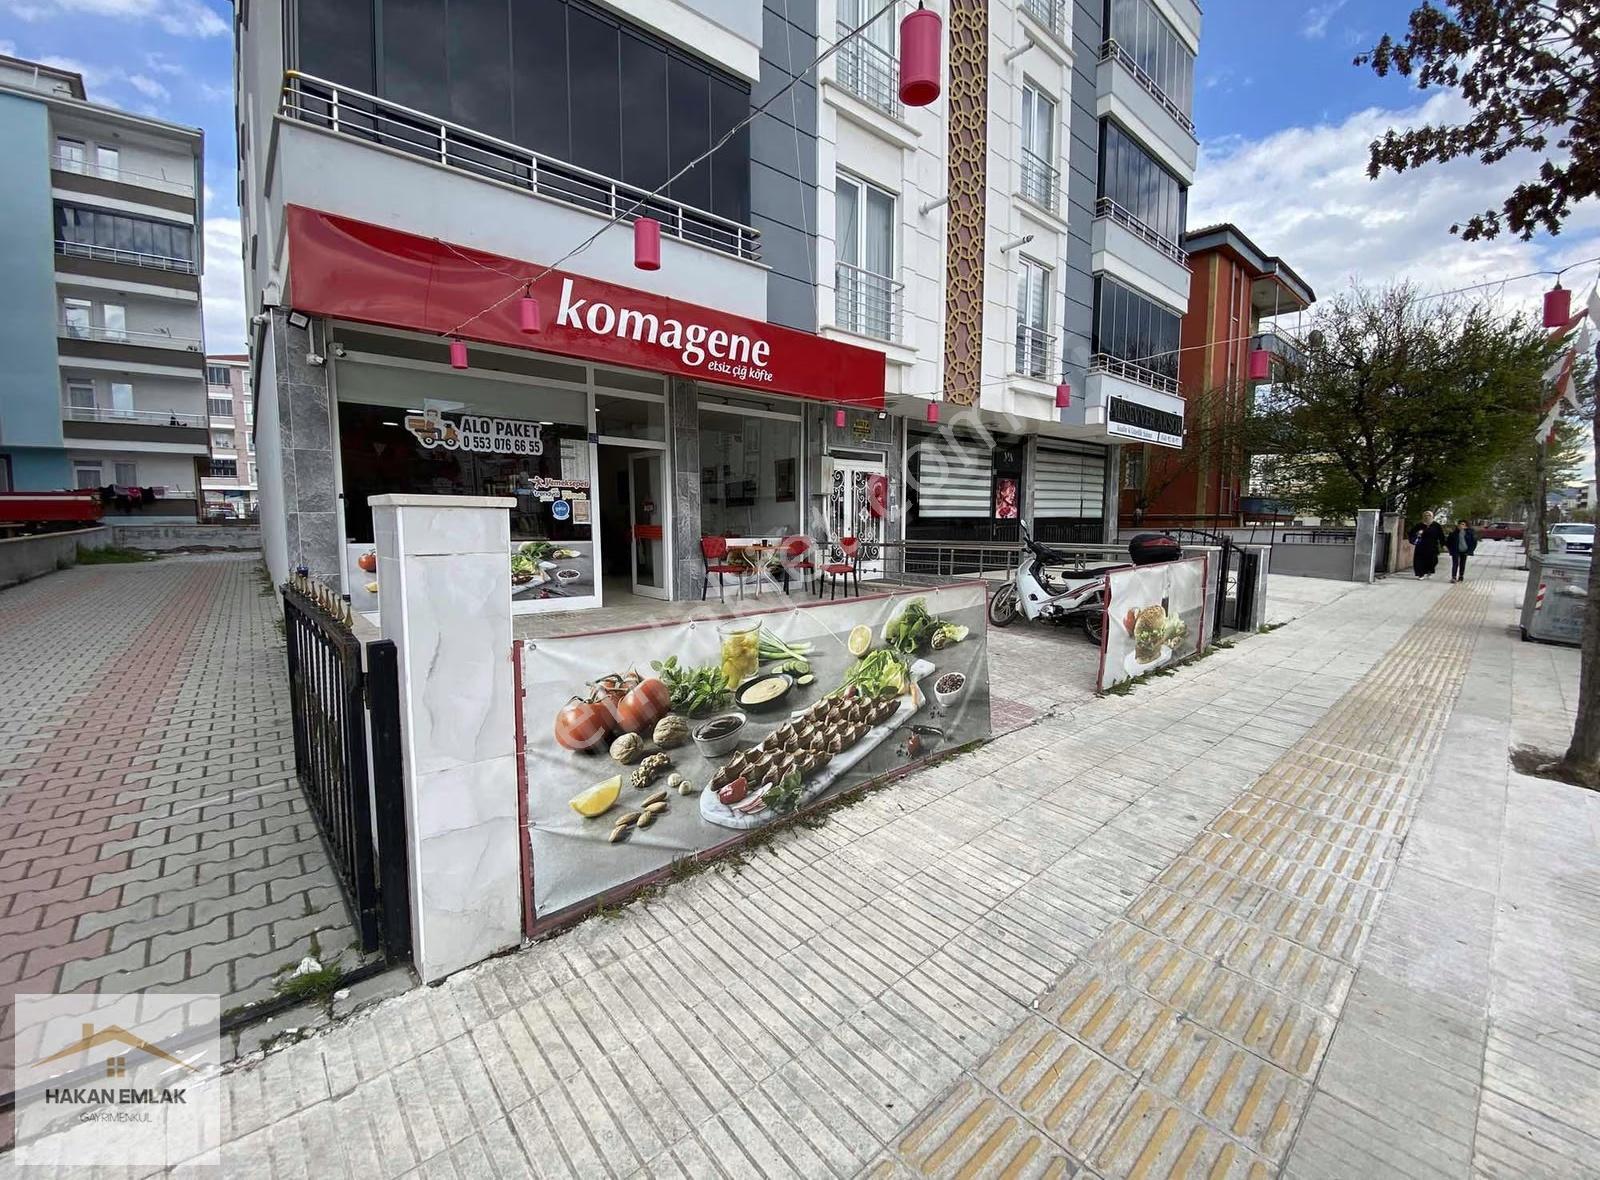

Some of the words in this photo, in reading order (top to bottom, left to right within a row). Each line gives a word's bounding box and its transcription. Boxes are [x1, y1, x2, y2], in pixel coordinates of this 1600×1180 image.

[556, 278, 770, 367] komagene
[708, 360, 731, 374] etsiz
[732, 365, 747, 380] çiğ
[749, 367, 773, 381] köfte
[463, 419, 490, 434] ALO
[496, 422, 539, 438] PAKET
[463, 436, 469, 448] 0
[473, 436, 491, 449] 553
[494, 438, 511, 451] 076
[514, 440, 526, 452] 66
[528, 441, 540, 453] 55
